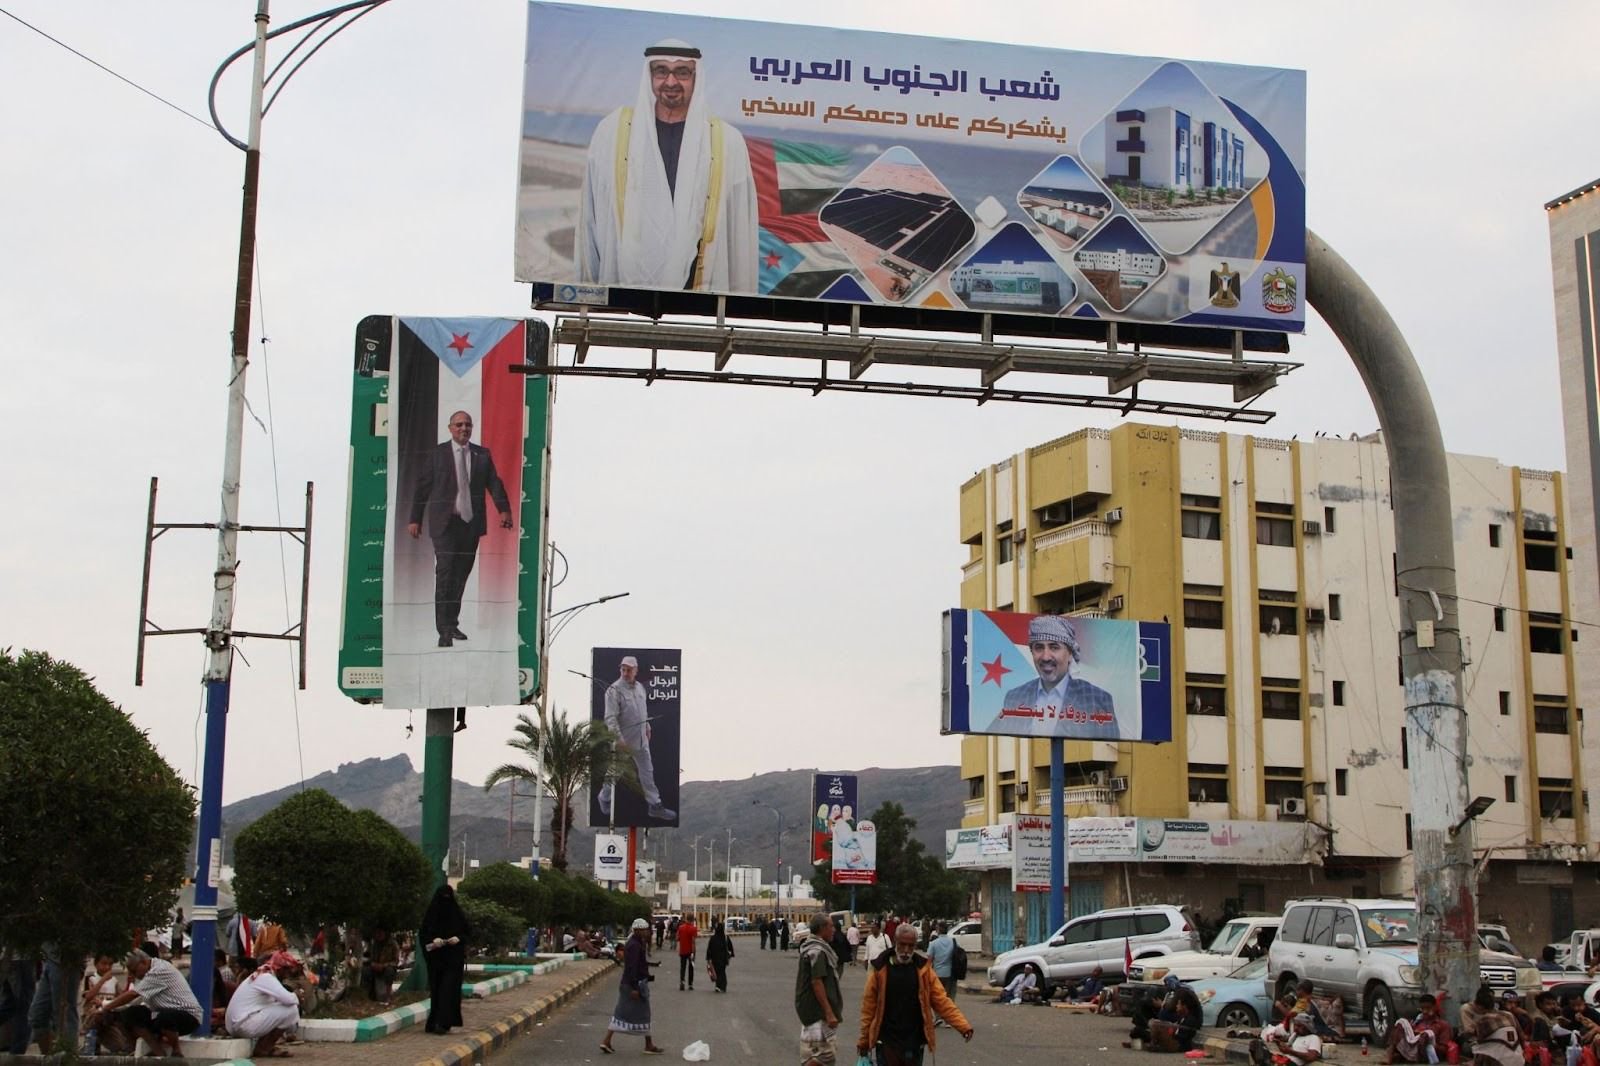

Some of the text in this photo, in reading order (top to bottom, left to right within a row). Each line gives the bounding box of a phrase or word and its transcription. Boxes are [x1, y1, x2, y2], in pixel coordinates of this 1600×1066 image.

[749, 56, 1060, 102] شعب الجنوب العربي
[741, 96, 1066, 143] يشكركم على دعمكم السخي
[649, 676, 677, 688] الرجال
[648, 689, 678, 701] للرجال
[999, 703, 1045, 722] ينكسر
[1047, 704, 1056, 718] لا
[1058, 704, 1087, 724] ووفاء
